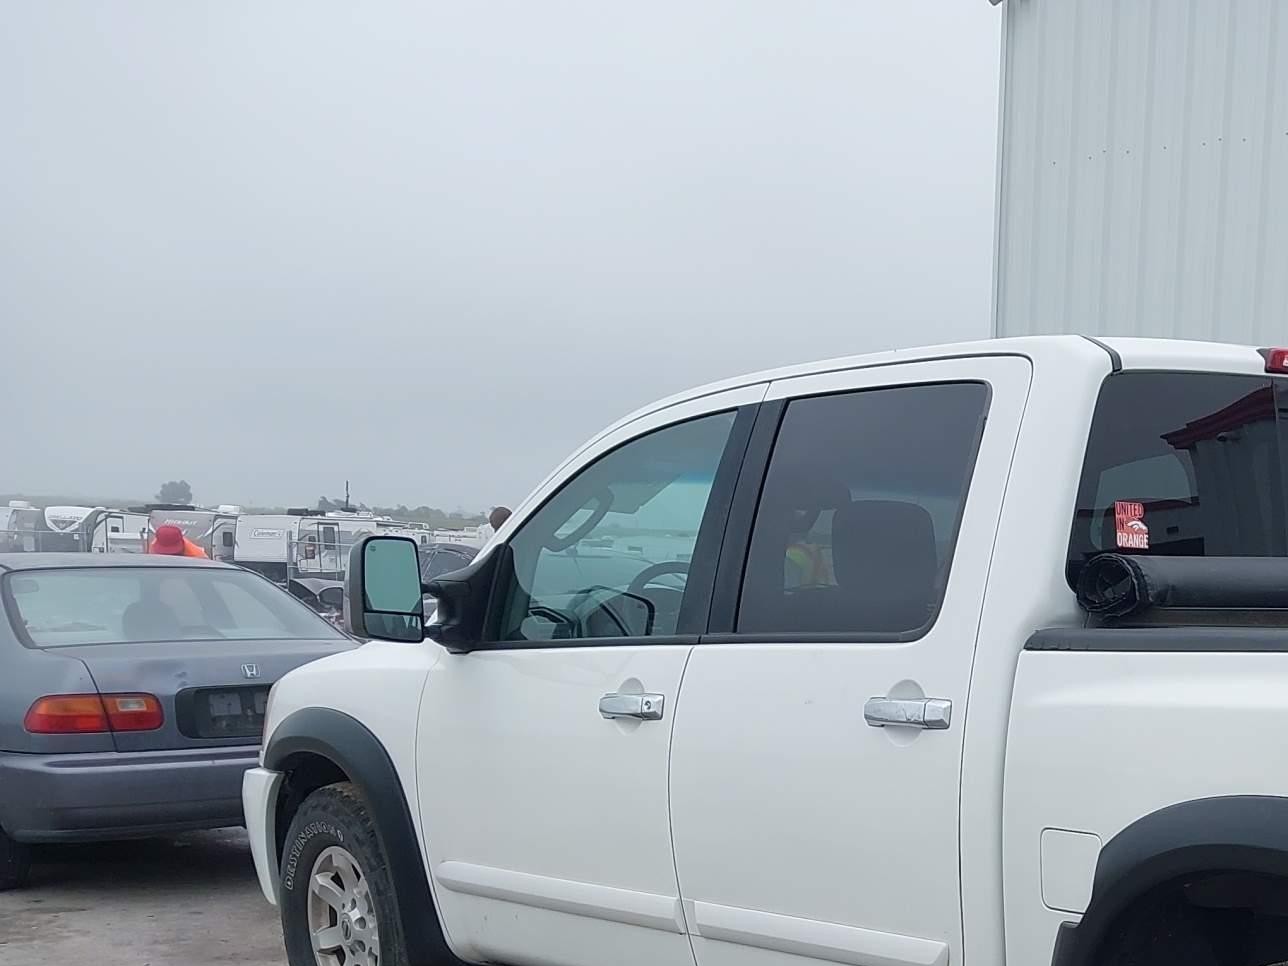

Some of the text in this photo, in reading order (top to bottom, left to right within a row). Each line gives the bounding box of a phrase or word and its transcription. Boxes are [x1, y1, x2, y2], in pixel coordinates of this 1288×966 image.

[1116, 502, 1144, 517] UNITED
[1117, 517, 1126, 531] IN
[1117, 532, 1149, 549] ORANGE
